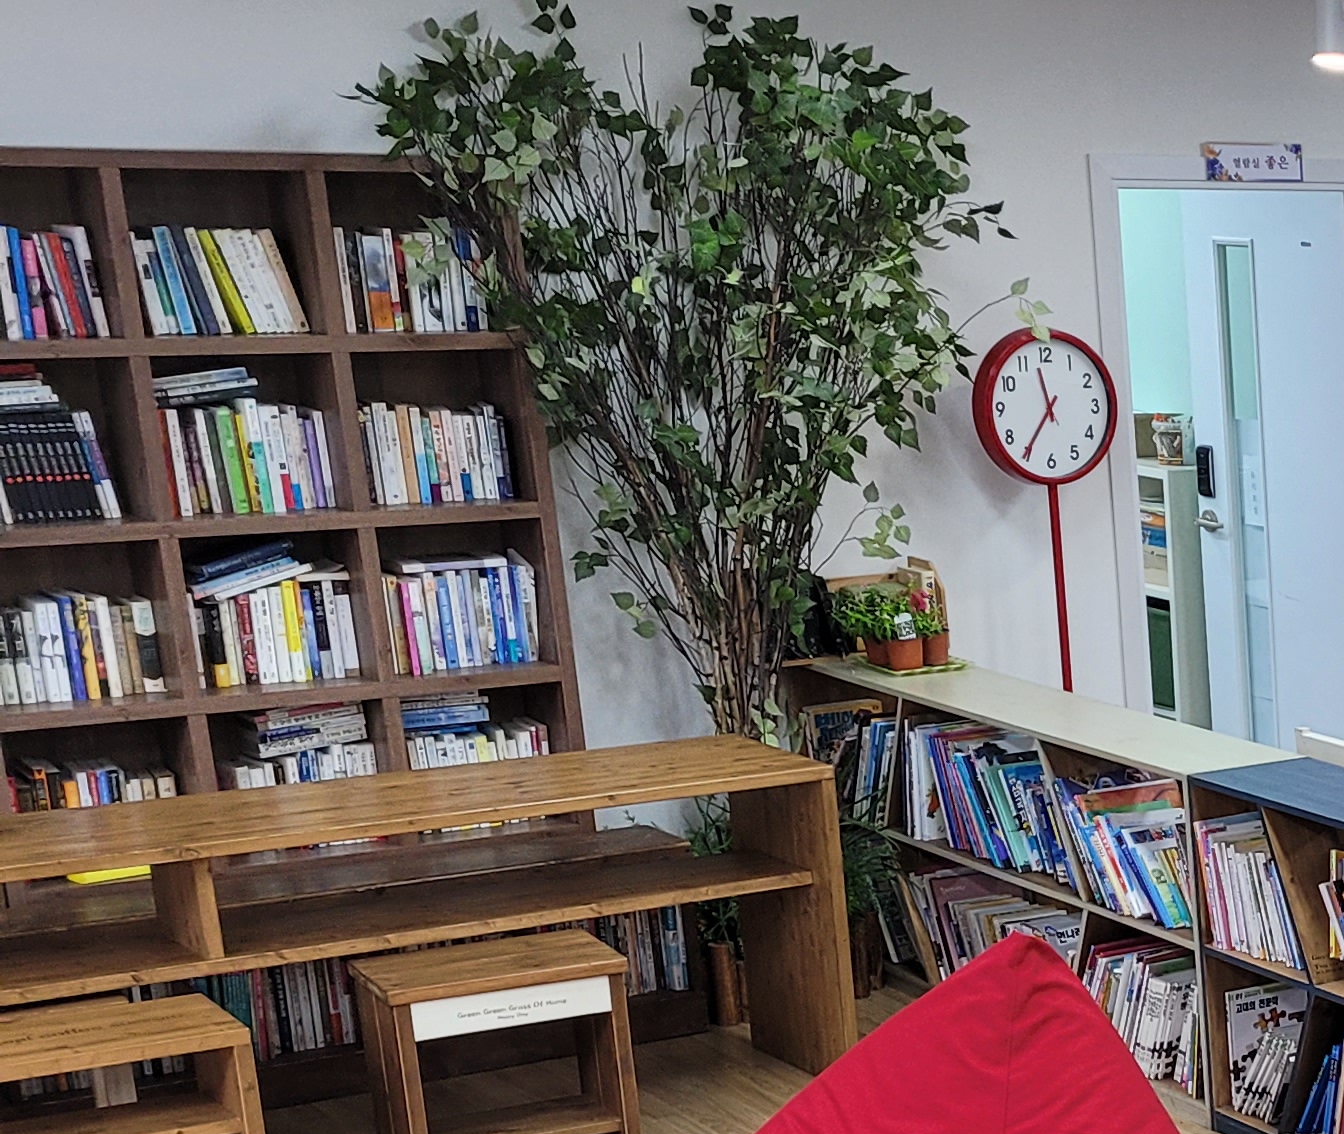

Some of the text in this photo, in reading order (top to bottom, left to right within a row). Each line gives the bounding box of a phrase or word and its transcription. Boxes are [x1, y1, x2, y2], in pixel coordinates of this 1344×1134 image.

[1265, 155, 1289, 170] 좋은
[1039, 347, 1052, 363] 12
[1066, 354, 1072, 371] 1
[1017, 355, 1028, 372] 11
[1001, 375, 1016, 392] 10
[1082, 373, 1092, 389] 2
[995, 401, 1005, 417] 9
[1090, 398, 1100, 414] 3
[1005, 429, 1014, 445] 8
[1084, 424, 1094, 440] 4
[1046, 453, 1056, 469] 6
[1069, 445, 1079, 461] 5
[457, 1011, 481, 1019] Green
[483, 1008, 507, 1016] Green
[508, 1004, 532, 1012] Grass
